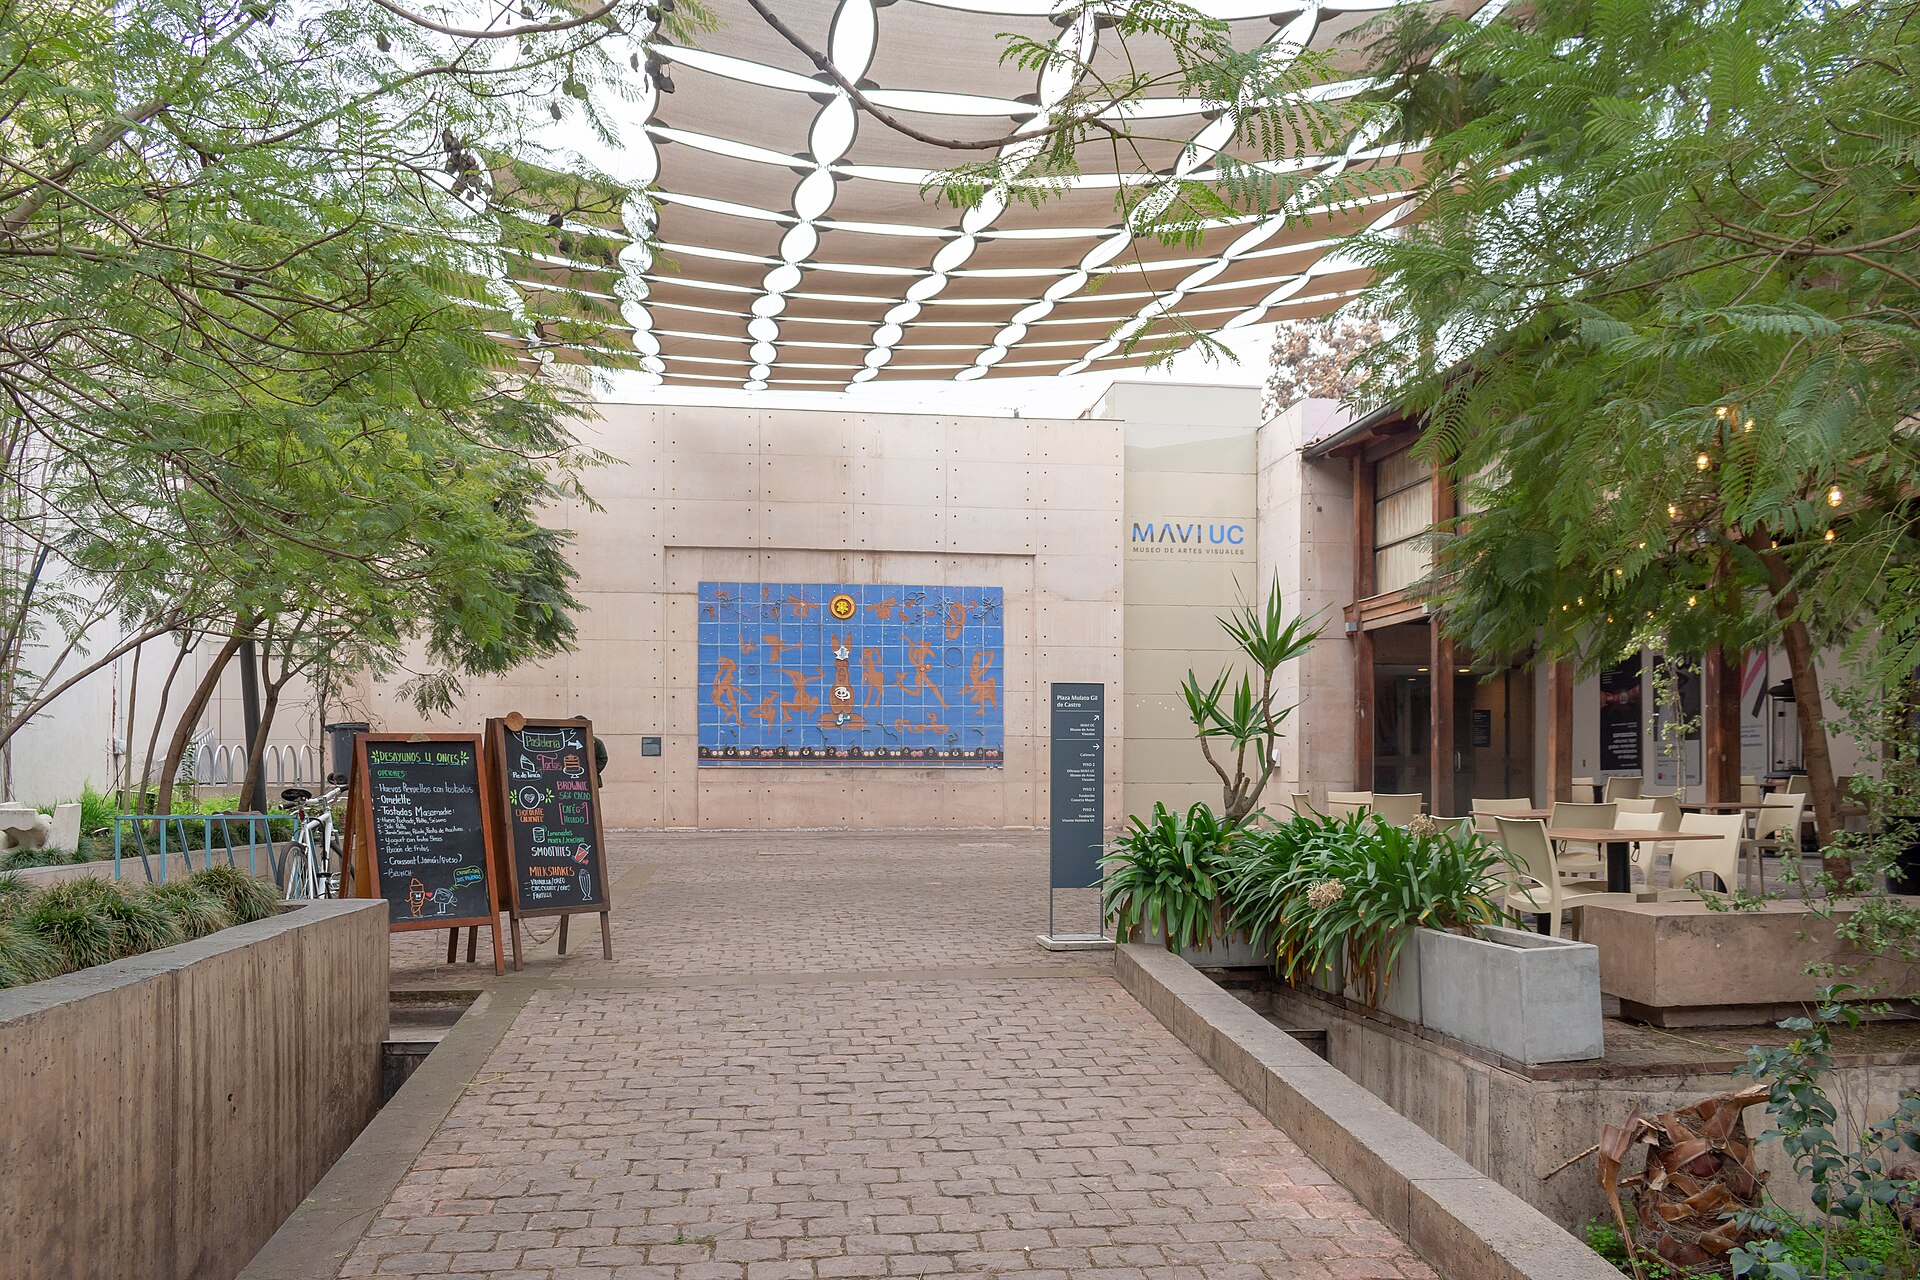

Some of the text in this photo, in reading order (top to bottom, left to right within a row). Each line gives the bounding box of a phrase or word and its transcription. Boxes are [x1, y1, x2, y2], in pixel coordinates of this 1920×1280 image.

[1132, 523, 1244, 544] MAVI UC
[380, 751, 421, 763] DESAYUNOS
[436, 753, 460, 764] ONCES
[536, 753, 563, 770] Tortas
[378, 783, 402, 793] Huevos
[556, 780, 589, 791] BROWNIE
[380, 793, 412, 805] Omelette
[380, 805, 413, 817] Tostadas
[531, 846, 572, 857] SMOOTHIES
